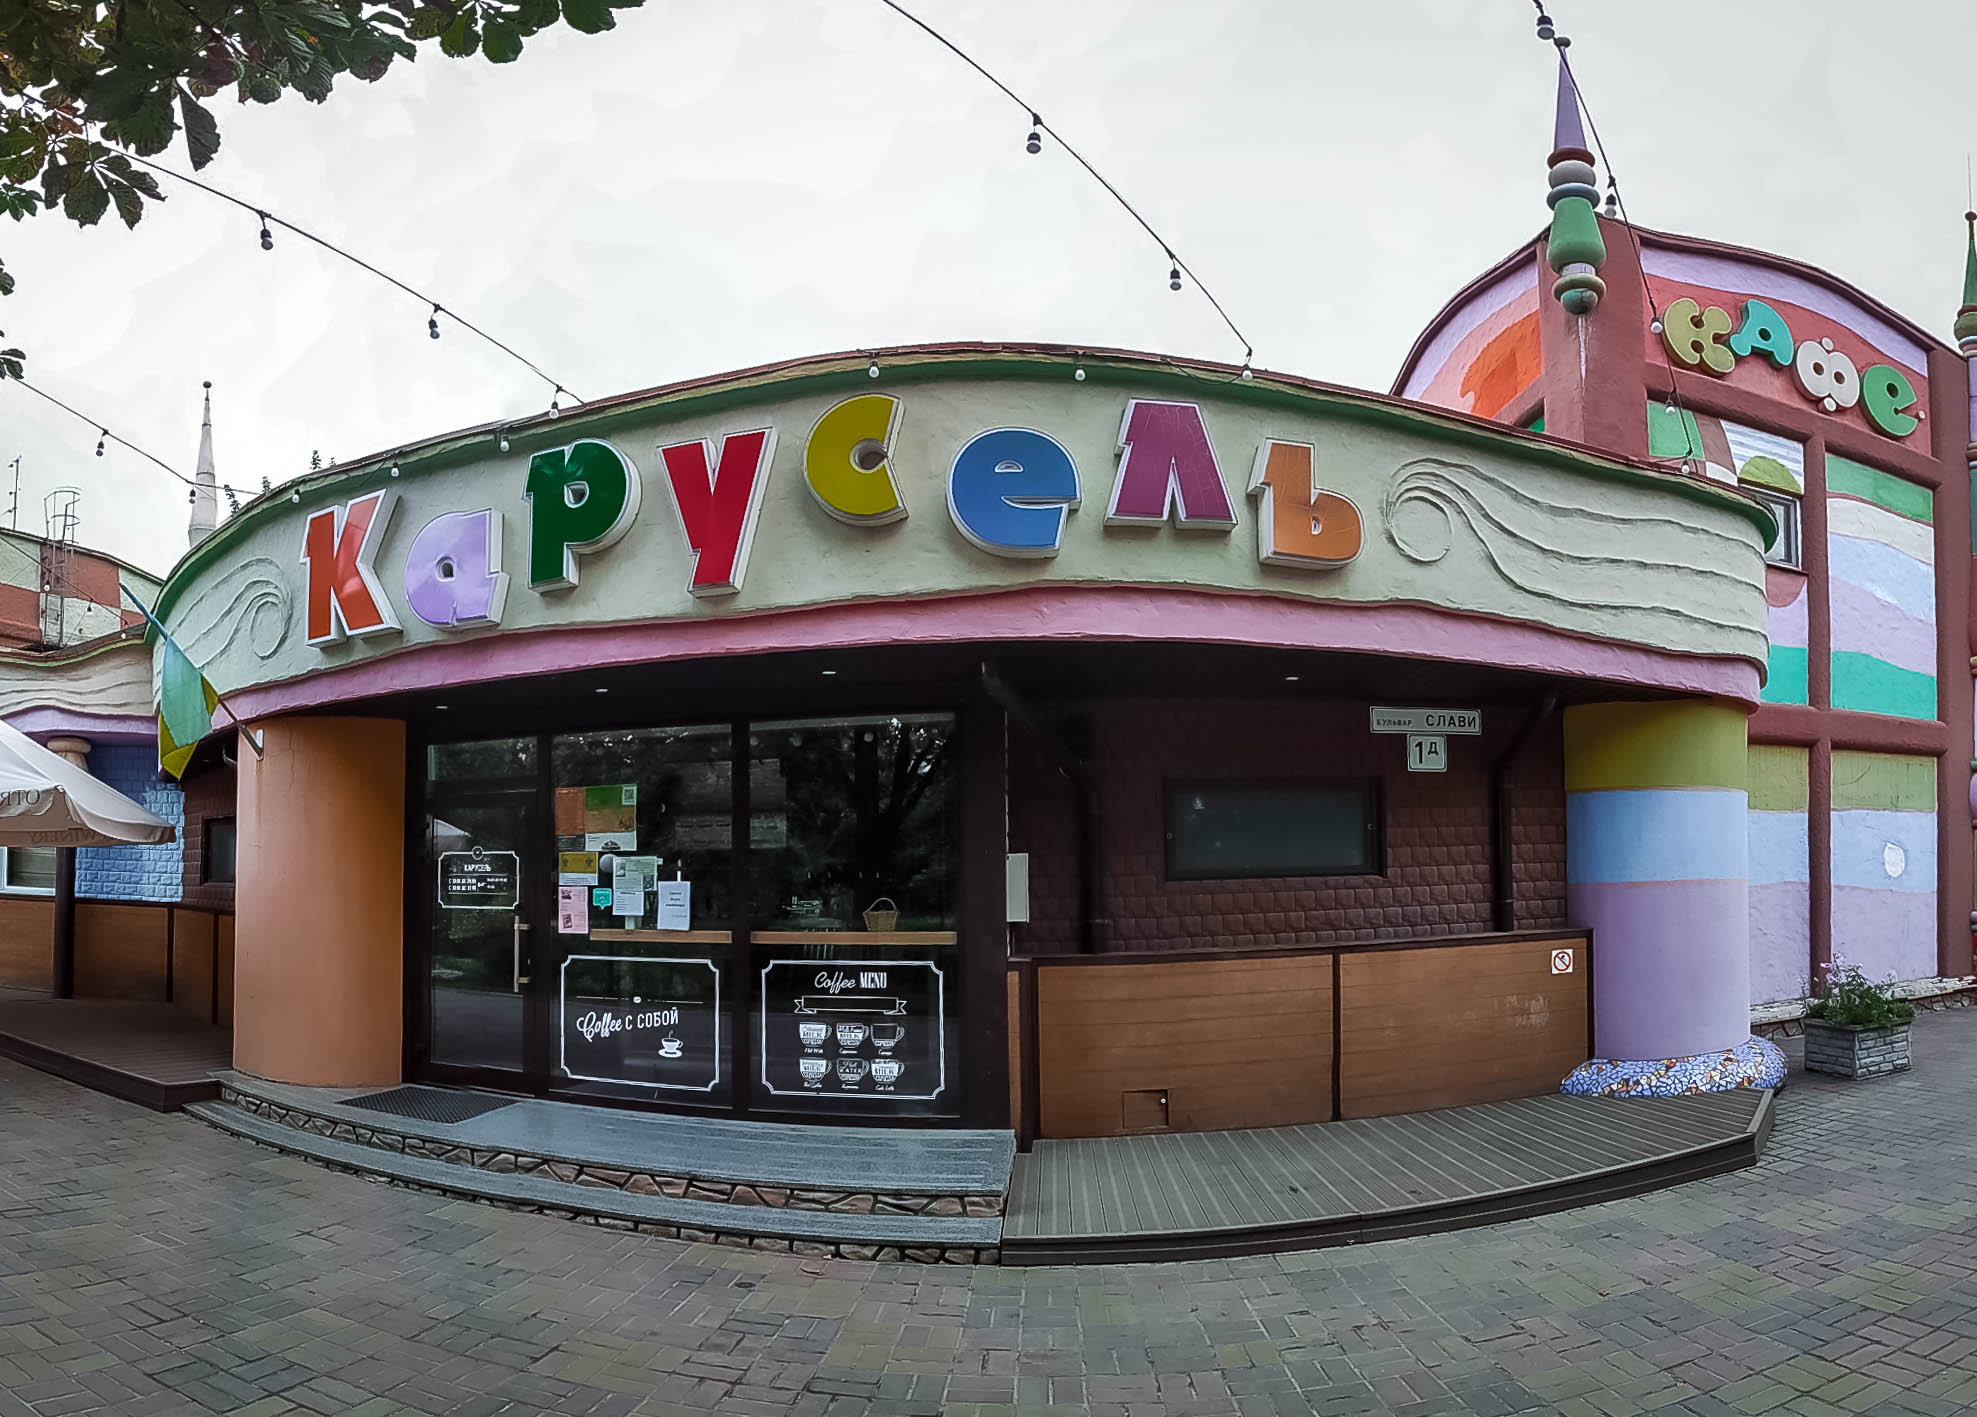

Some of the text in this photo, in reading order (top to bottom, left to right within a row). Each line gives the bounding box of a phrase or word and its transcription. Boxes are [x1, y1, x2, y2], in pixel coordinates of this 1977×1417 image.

[1425, 714, 1477, 729] СЛАВИ
[814, 971, 887, 993] Coffee MENU
[576, 1011, 623, 1042] Coffee
